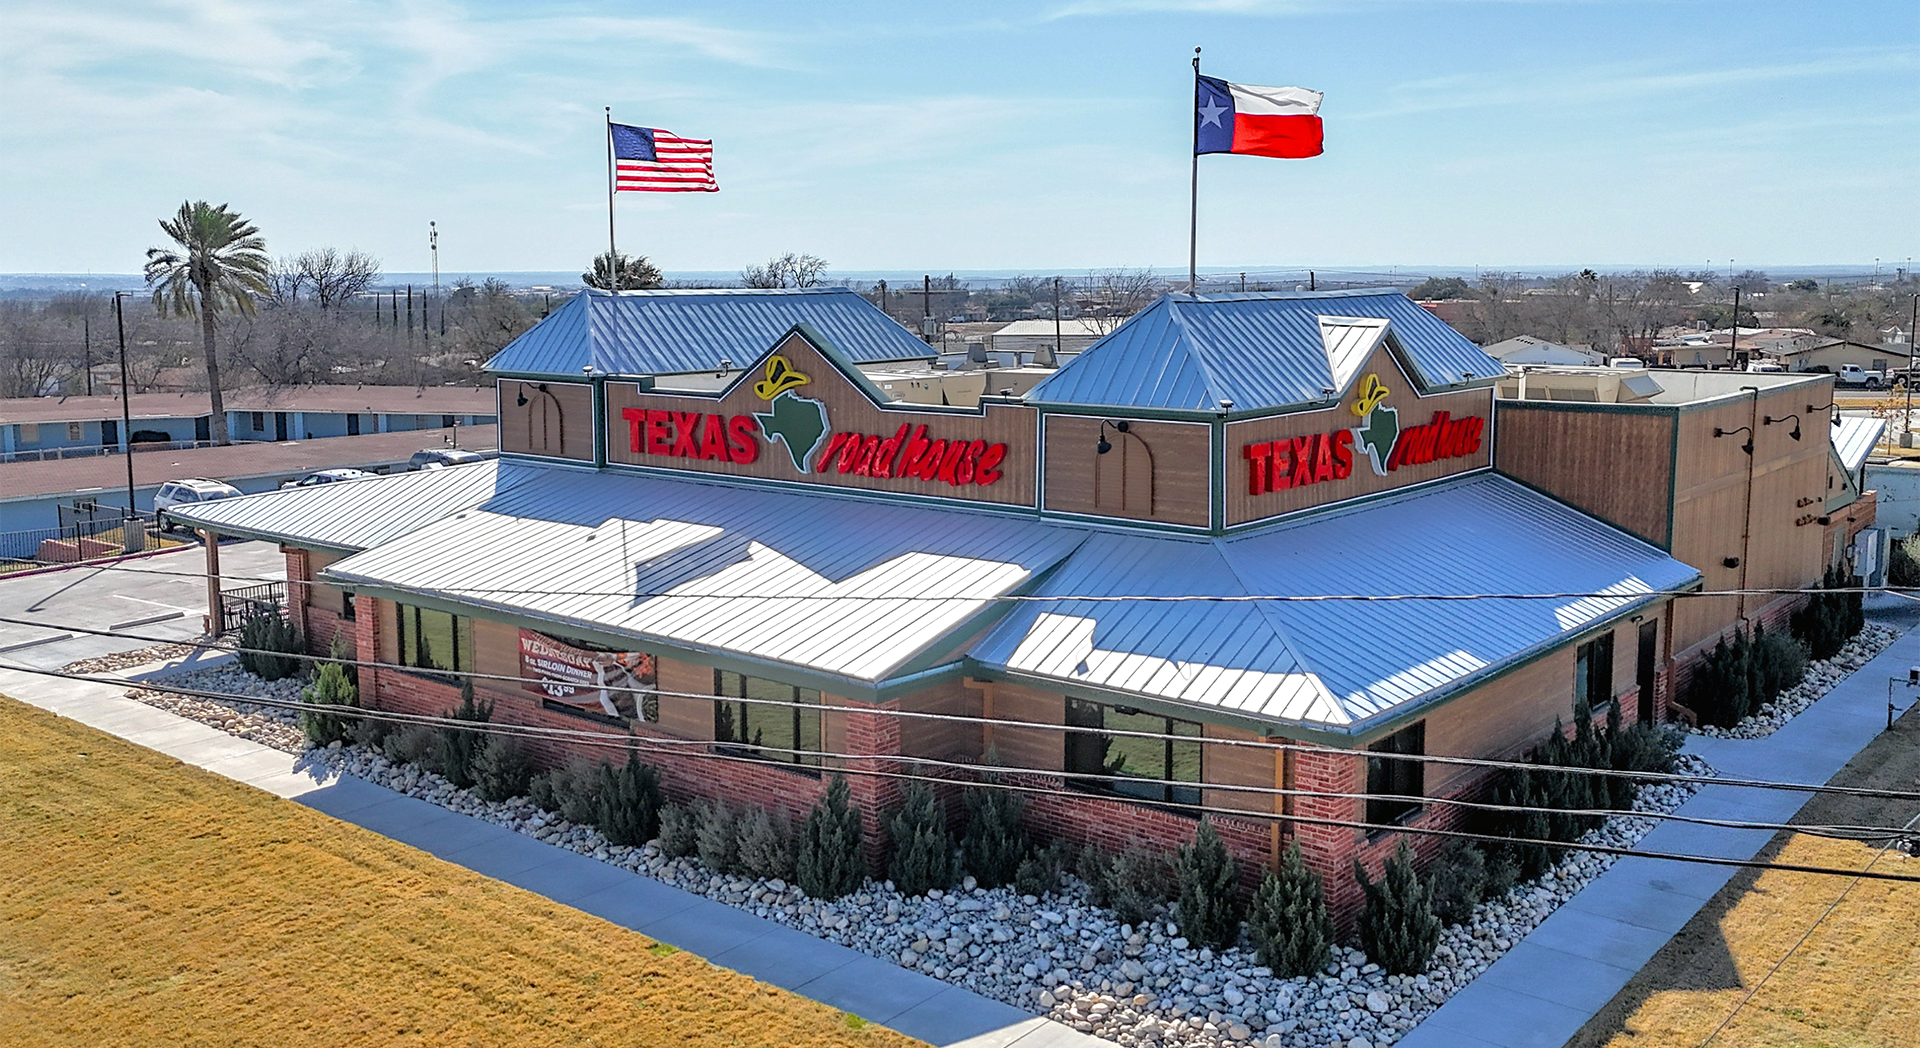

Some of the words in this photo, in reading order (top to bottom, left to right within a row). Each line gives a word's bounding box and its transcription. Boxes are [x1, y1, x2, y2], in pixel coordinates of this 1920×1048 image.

[622, 408, 761, 465] TEXAS
[1243, 429, 1353, 496] TEXAS
[521, 638, 592, 668] WEDNESDAY
[537, 659, 566, 673] SIRLOIN
[566, 666, 593, 679] DINNER
